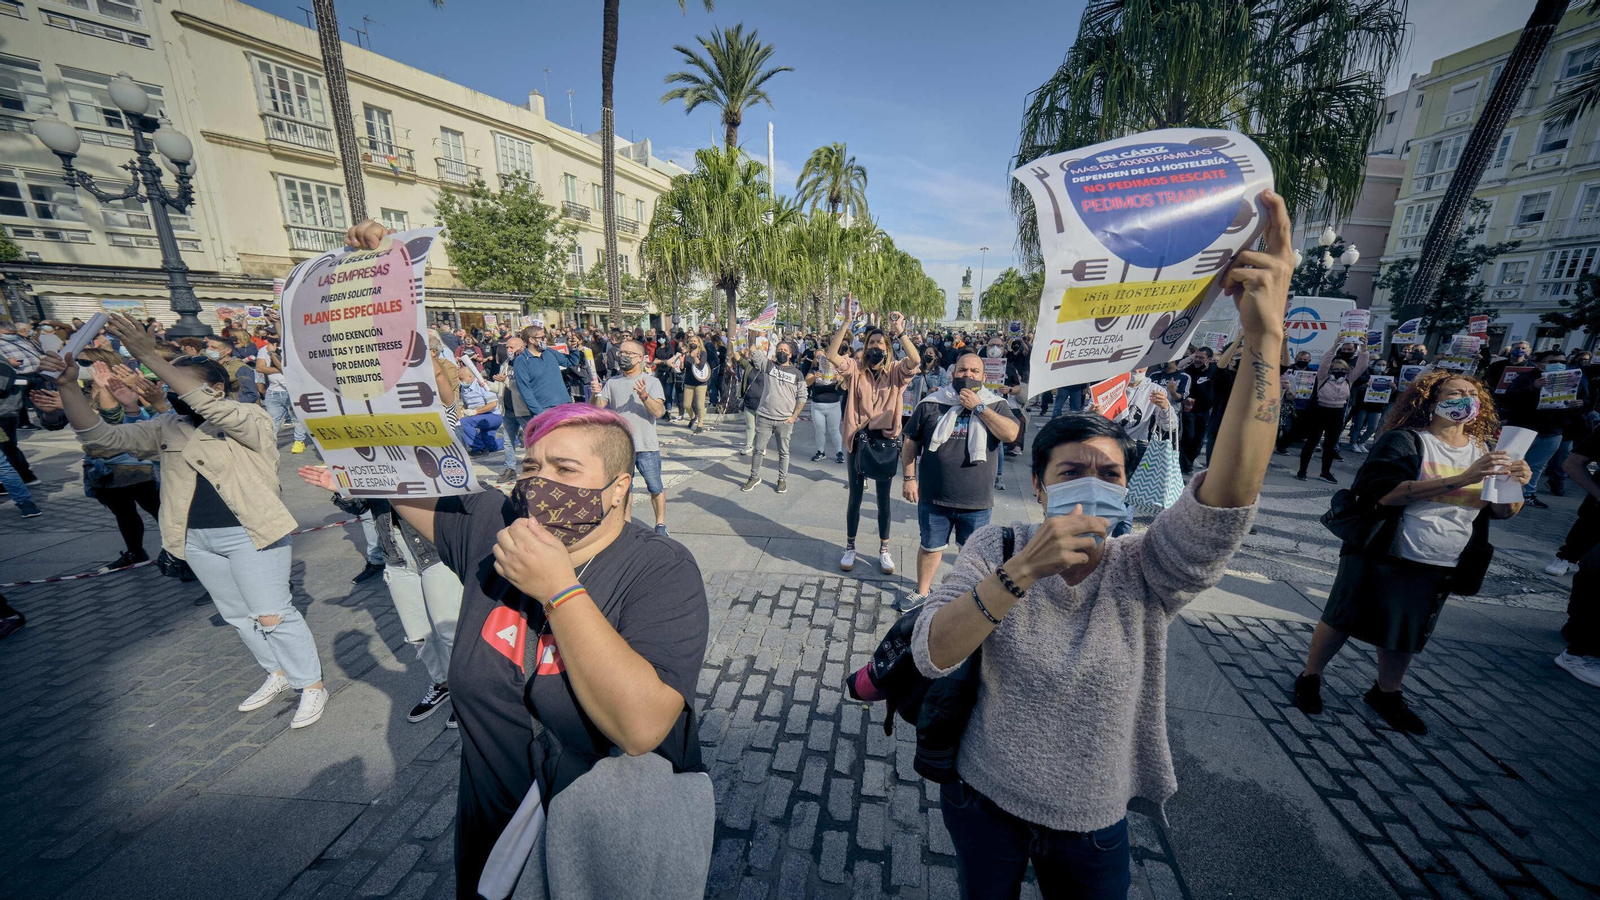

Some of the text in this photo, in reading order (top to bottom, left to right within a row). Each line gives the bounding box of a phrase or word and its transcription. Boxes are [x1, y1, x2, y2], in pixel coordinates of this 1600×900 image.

[1096, 146, 1169, 164] EN CÁDIZ
[1100, 162, 1118, 170] DE
[1119, 156, 1155, 167] 40000
[1155, 148, 1213, 161] FAMILIAS
[1072, 157, 1230, 183] DEPENDEN DE LA HOSTELERÍA.
[1083, 169, 1228, 193] NO PEDIMOS RESCATE
[1081, 193, 1155, 213] PEDIMOS
[318, 263, 390, 287] LAS EMPRESAS
[321, 286, 382, 304] PUEDEN SOLICITAR
[303, 299, 403, 326] PLANES ESPECIALES
[1090, 304, 1131, 316] CÁDIZ
[322, 326, 383, 343] COMO EXENCIÓN
[1067, 331, 1123, 347] HOSTELERÍA
[308, 340, 403, 359] DE MULTAS Y DE INTERESES
[1063, 345, 1114, 359] DE ESPAÑA
[332, 358, 381, 371] POR DEMORA
[335, 372, 384, 385] EN TRIBUTOS.
[317, 421, 438, 440] EN ESPAÑA NO
[348, 462, 398, 475] HOSTELERÍA
[353, 475, 397, 487] DE ESPAÑA
